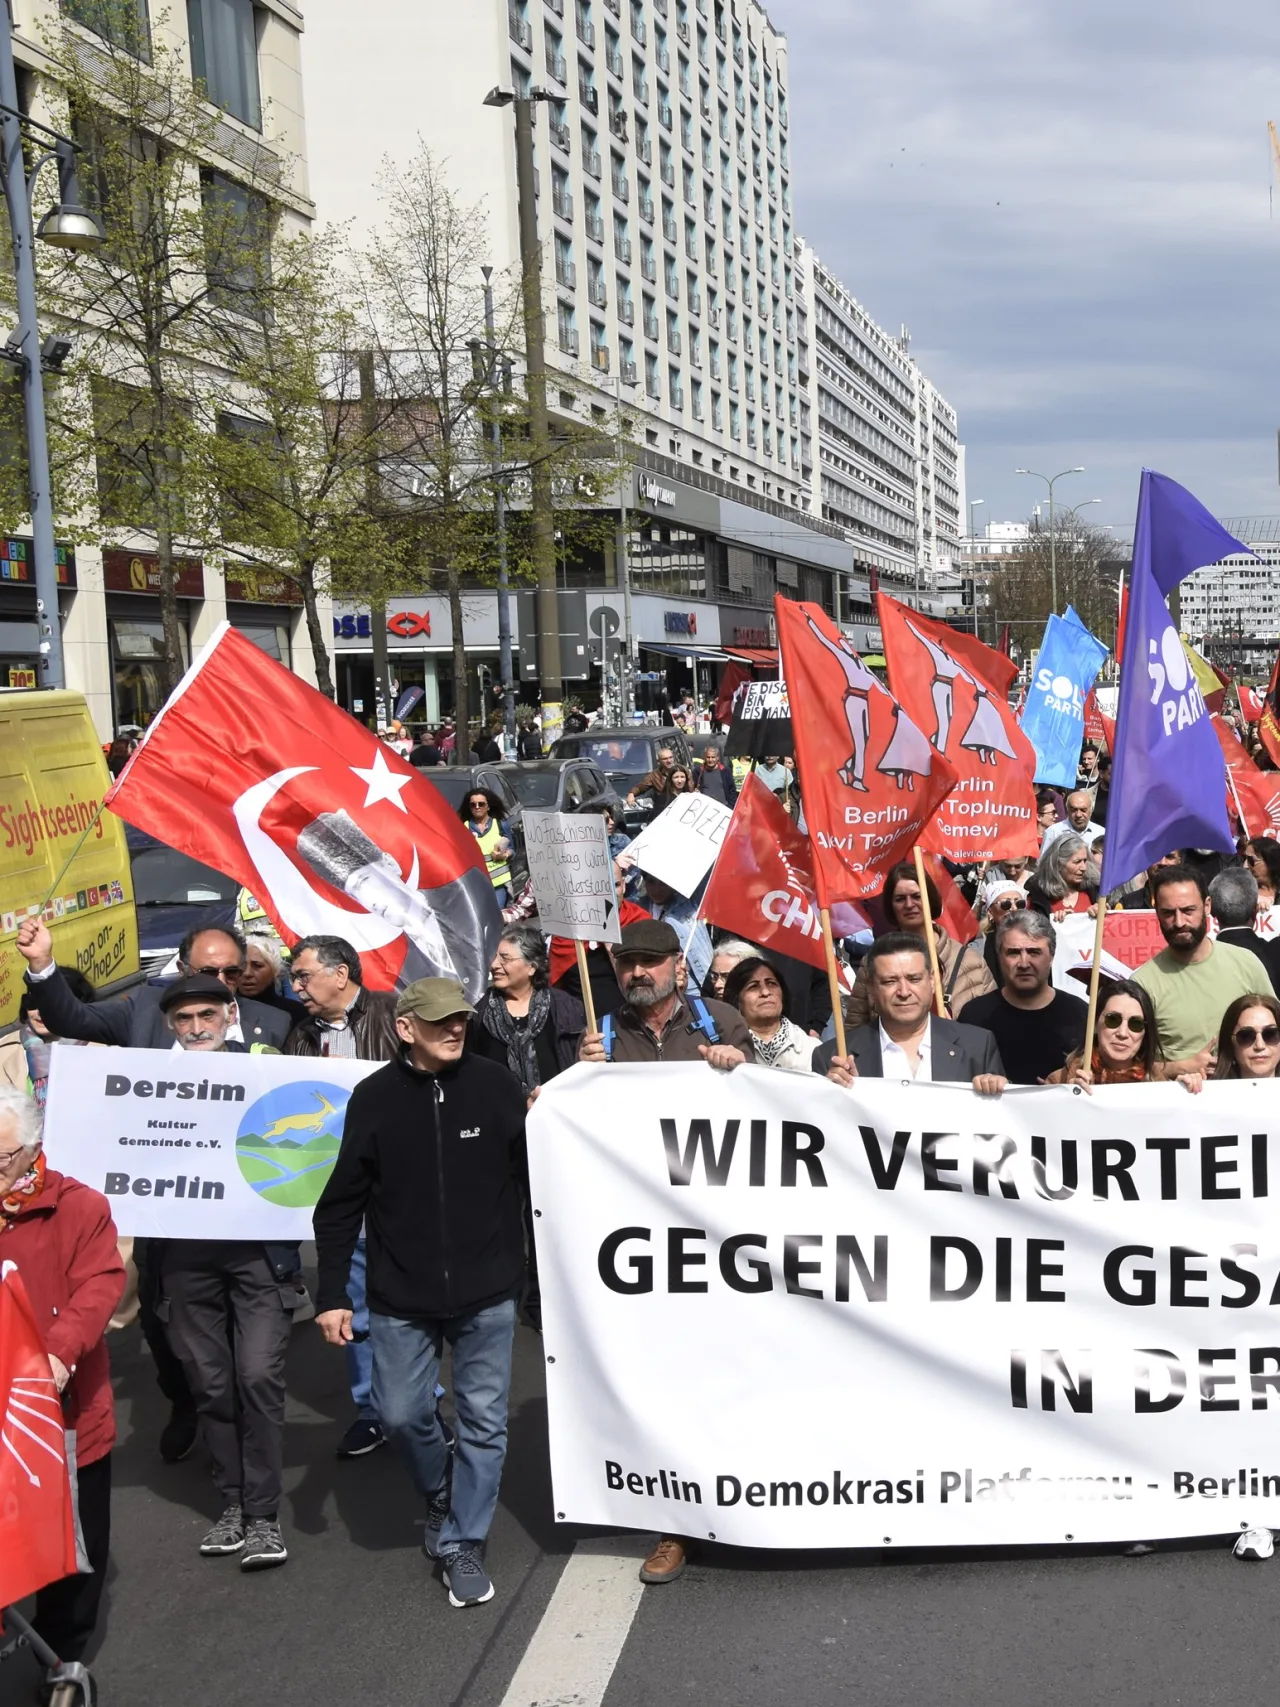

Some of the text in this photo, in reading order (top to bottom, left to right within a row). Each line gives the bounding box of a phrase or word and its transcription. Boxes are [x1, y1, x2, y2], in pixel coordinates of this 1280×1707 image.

[1035, 668, 1082, 709] SOL
[952, 776, 994, 792] erlin
[844, 805, 908, 824] Berlin
[946, 799, 1031, 820] Toplumu
[0, 793, 103, 856] Sightseeing
[76, 949, 95, 971] hop
[93, 928, 125, 983] hop off
[104, 1074, 245, 1102] Dersim
[147, 1119, 197, 1130] Kultur
[118, 1136, 221, 1149] Gemeinde e.V.
[659, 1118, 828, 1188] WIR
[104, 1172, 225, 1200] Berlin
[597, 1226, 888, 1303] GEGEN
[930, 1235, 1066, 1303] DIE
[1010, 1348, 1093, 1414] IN
[605, 1460, 702, 1505] Berlin
[716, 1470, 924, 1507] Demokrasi
[940, 1467, 1133, 1503] Platfmu
